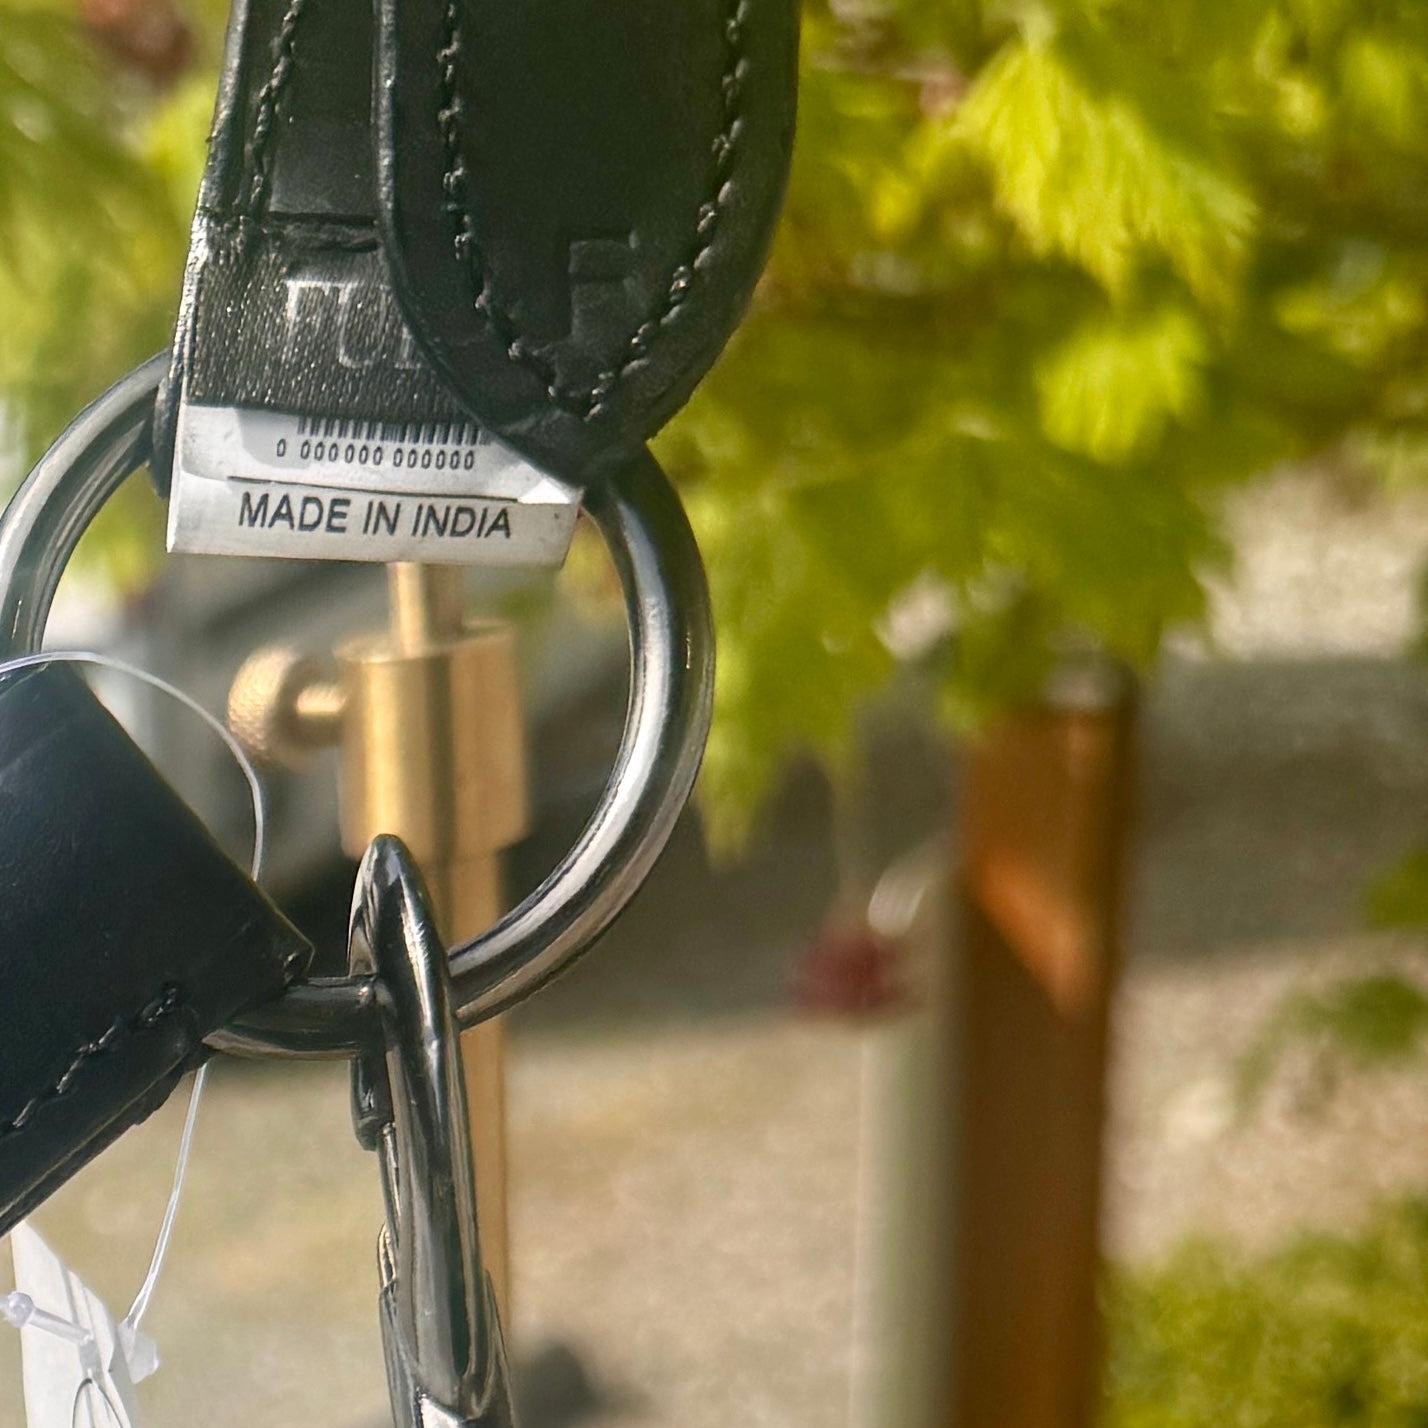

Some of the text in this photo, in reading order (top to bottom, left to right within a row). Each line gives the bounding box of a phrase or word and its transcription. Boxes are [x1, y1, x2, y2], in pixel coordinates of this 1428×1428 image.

[276, 438, 475, 471] 0 000000 000000
[238, 491, 512, 540] MADE IN INDIA
